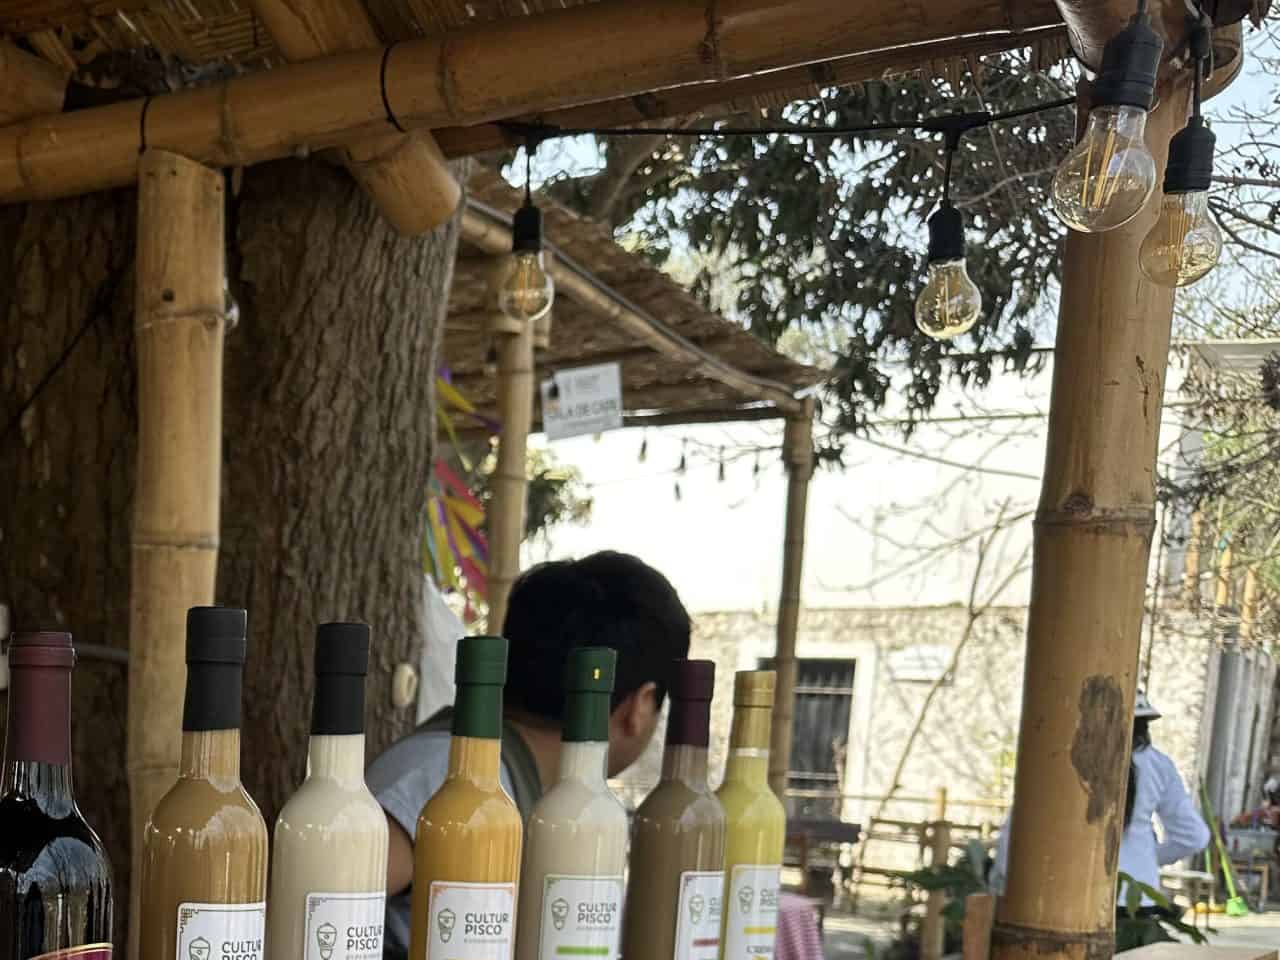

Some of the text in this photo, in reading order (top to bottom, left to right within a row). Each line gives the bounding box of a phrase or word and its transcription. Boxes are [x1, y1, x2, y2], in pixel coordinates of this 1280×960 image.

[577, 902, 617, 913] CULTUR
[464, 912, 509, 924] CULTUR
[577, 912, 612, 924] PISCO
[464, 924, 502, 936] PISCO
[346, 937, 378, 951] PISCO
